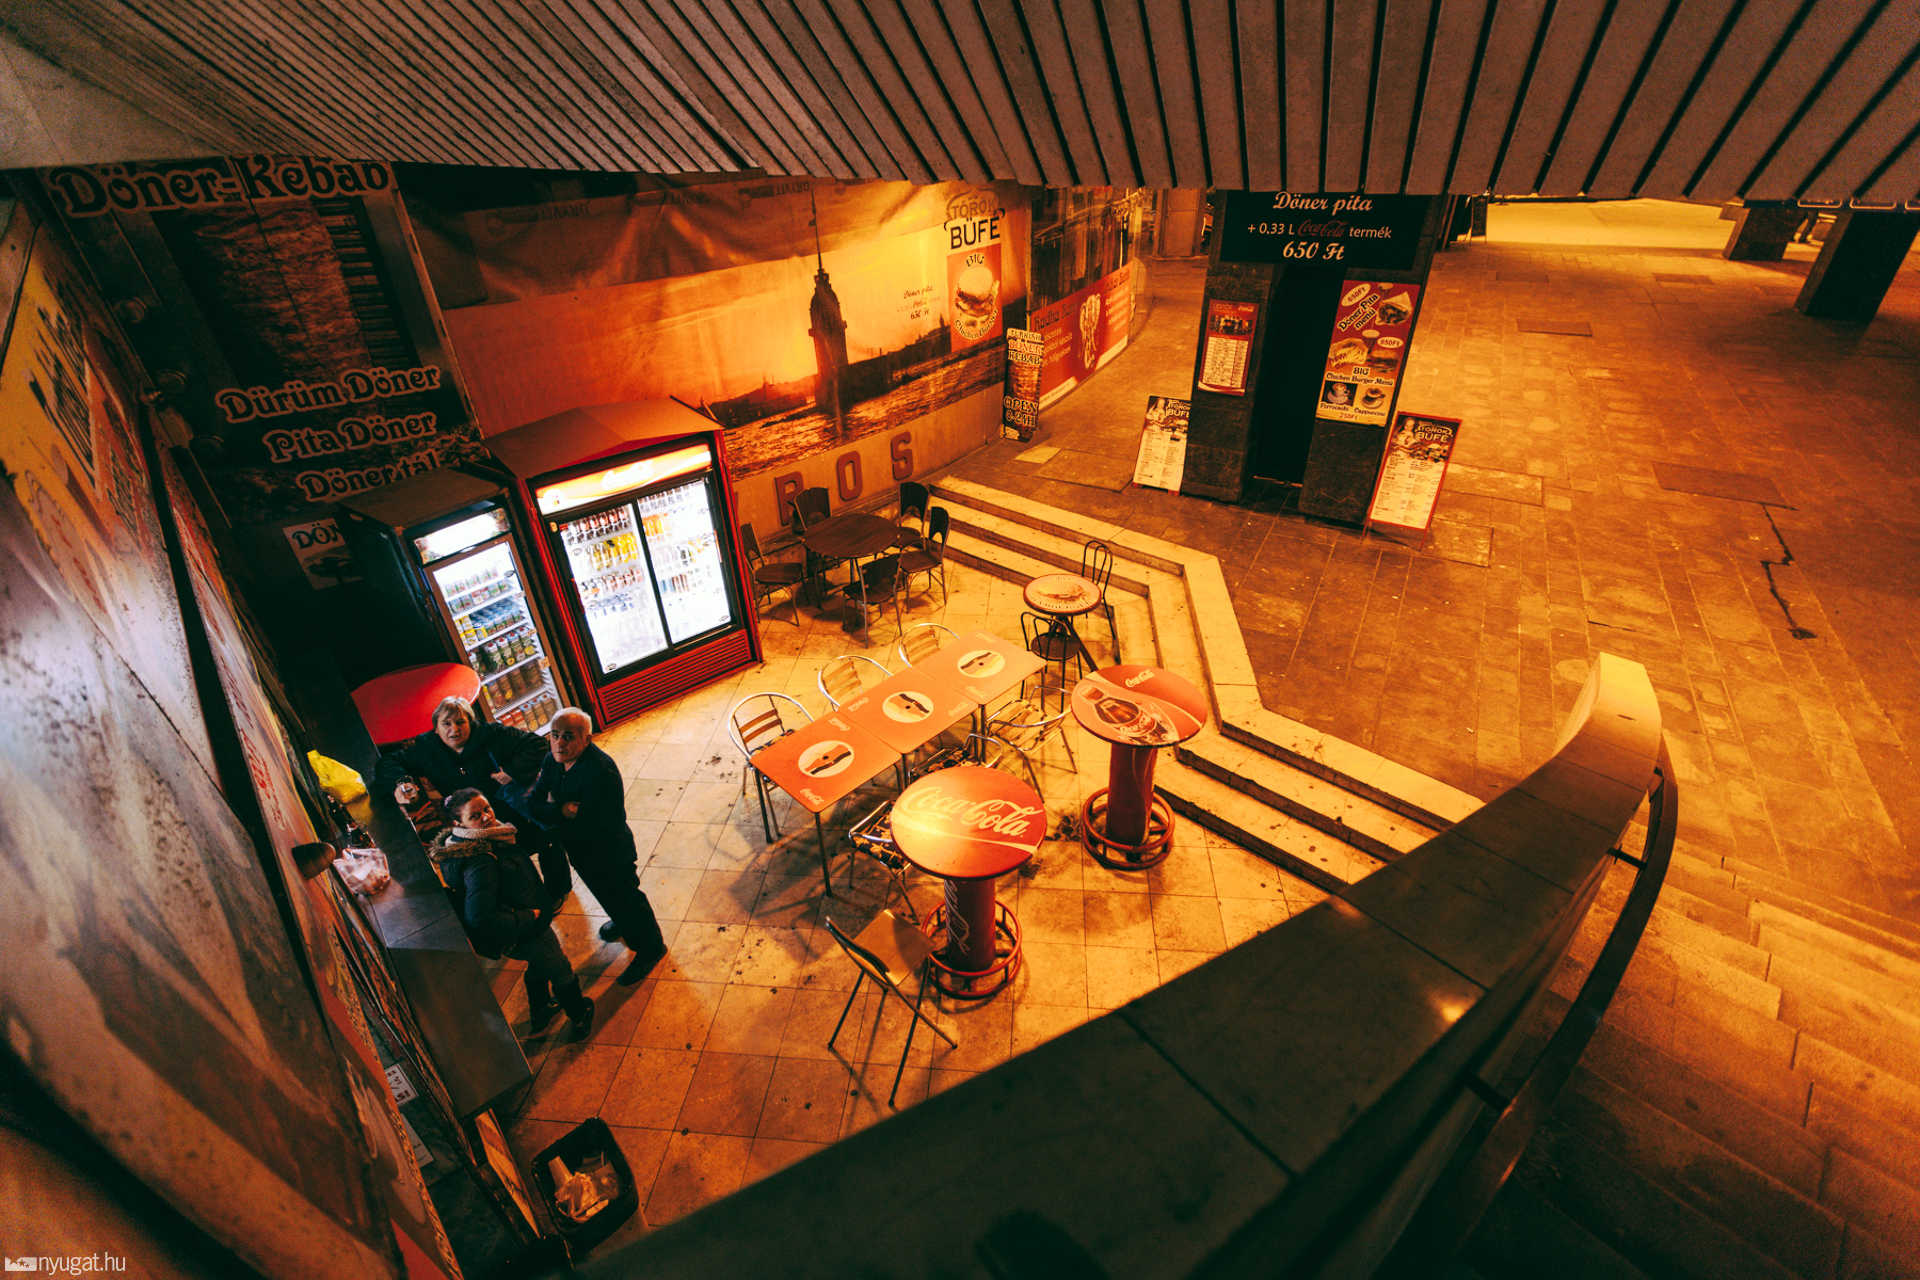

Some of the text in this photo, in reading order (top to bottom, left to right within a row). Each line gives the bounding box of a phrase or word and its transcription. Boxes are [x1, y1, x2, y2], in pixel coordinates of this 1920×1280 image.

[1273, 191, 1373, 216] Döner pita
[1259, 222, 1285, 235] 0.33
[1288, 223, 1296, 236] L
[1349, 226, 1393, 239] termék
[1283, 240, 1345, 261] 650 Ft
[215, 365, 441, 423] Dürüm Döner
[262, 412, 437, 463] Pita Döner
[296, 468, 397, 502] Döner
